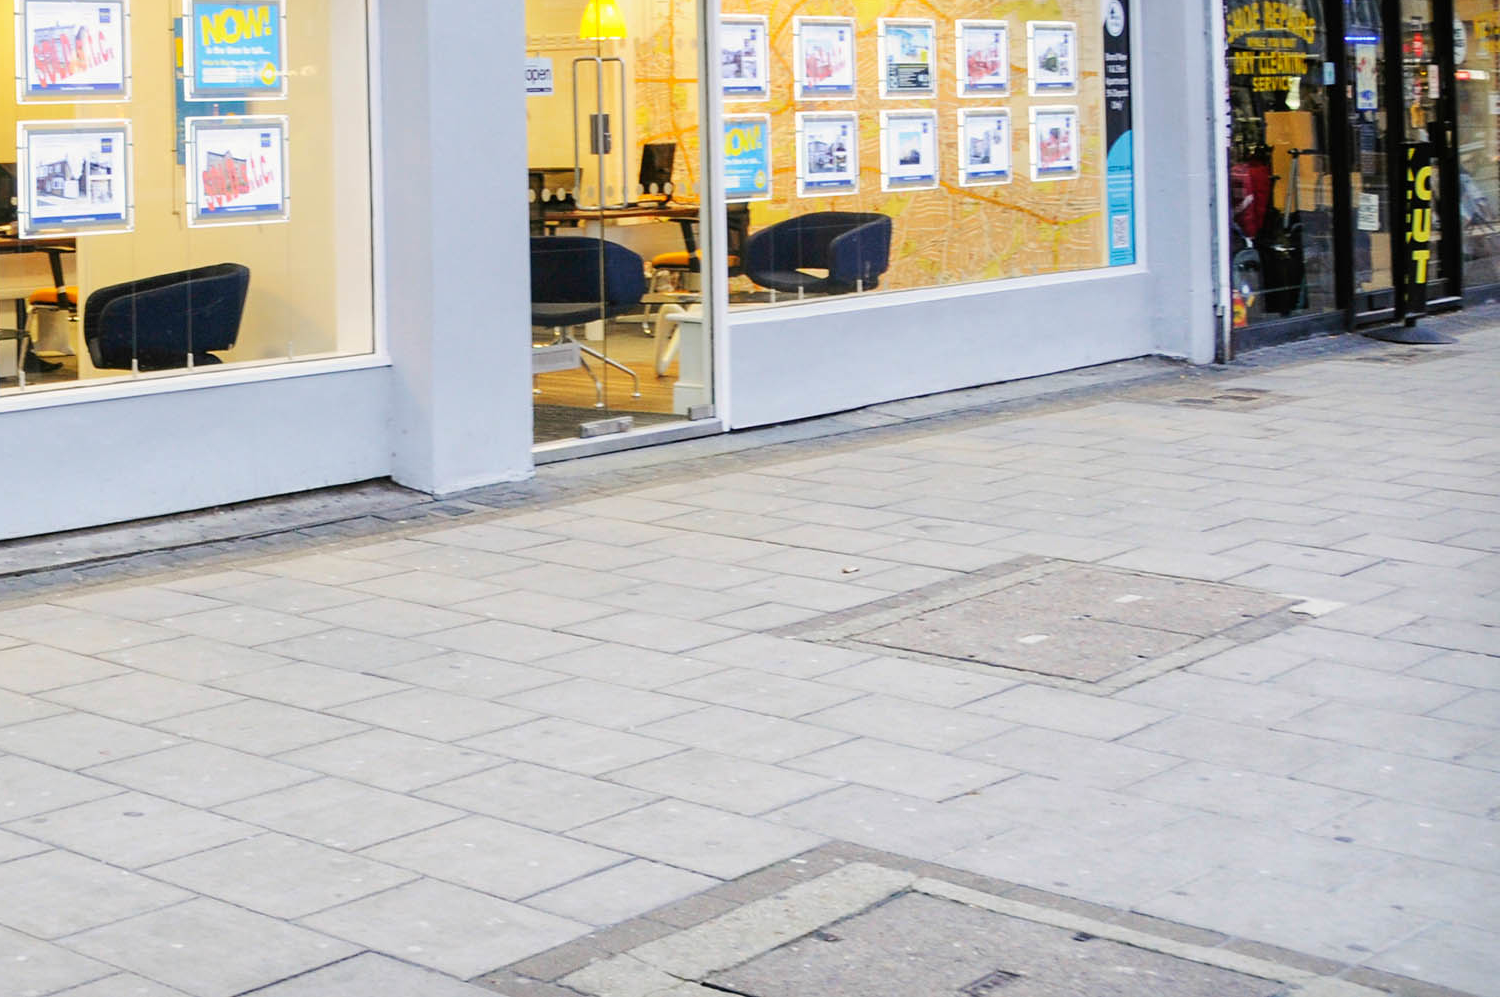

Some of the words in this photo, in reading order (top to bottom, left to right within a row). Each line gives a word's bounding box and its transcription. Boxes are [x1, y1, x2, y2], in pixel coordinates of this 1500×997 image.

[201, 5, 272, 46] NOW!
[525, 68, 552, 84] open
[1412, 166, 1431, 284] CUT
